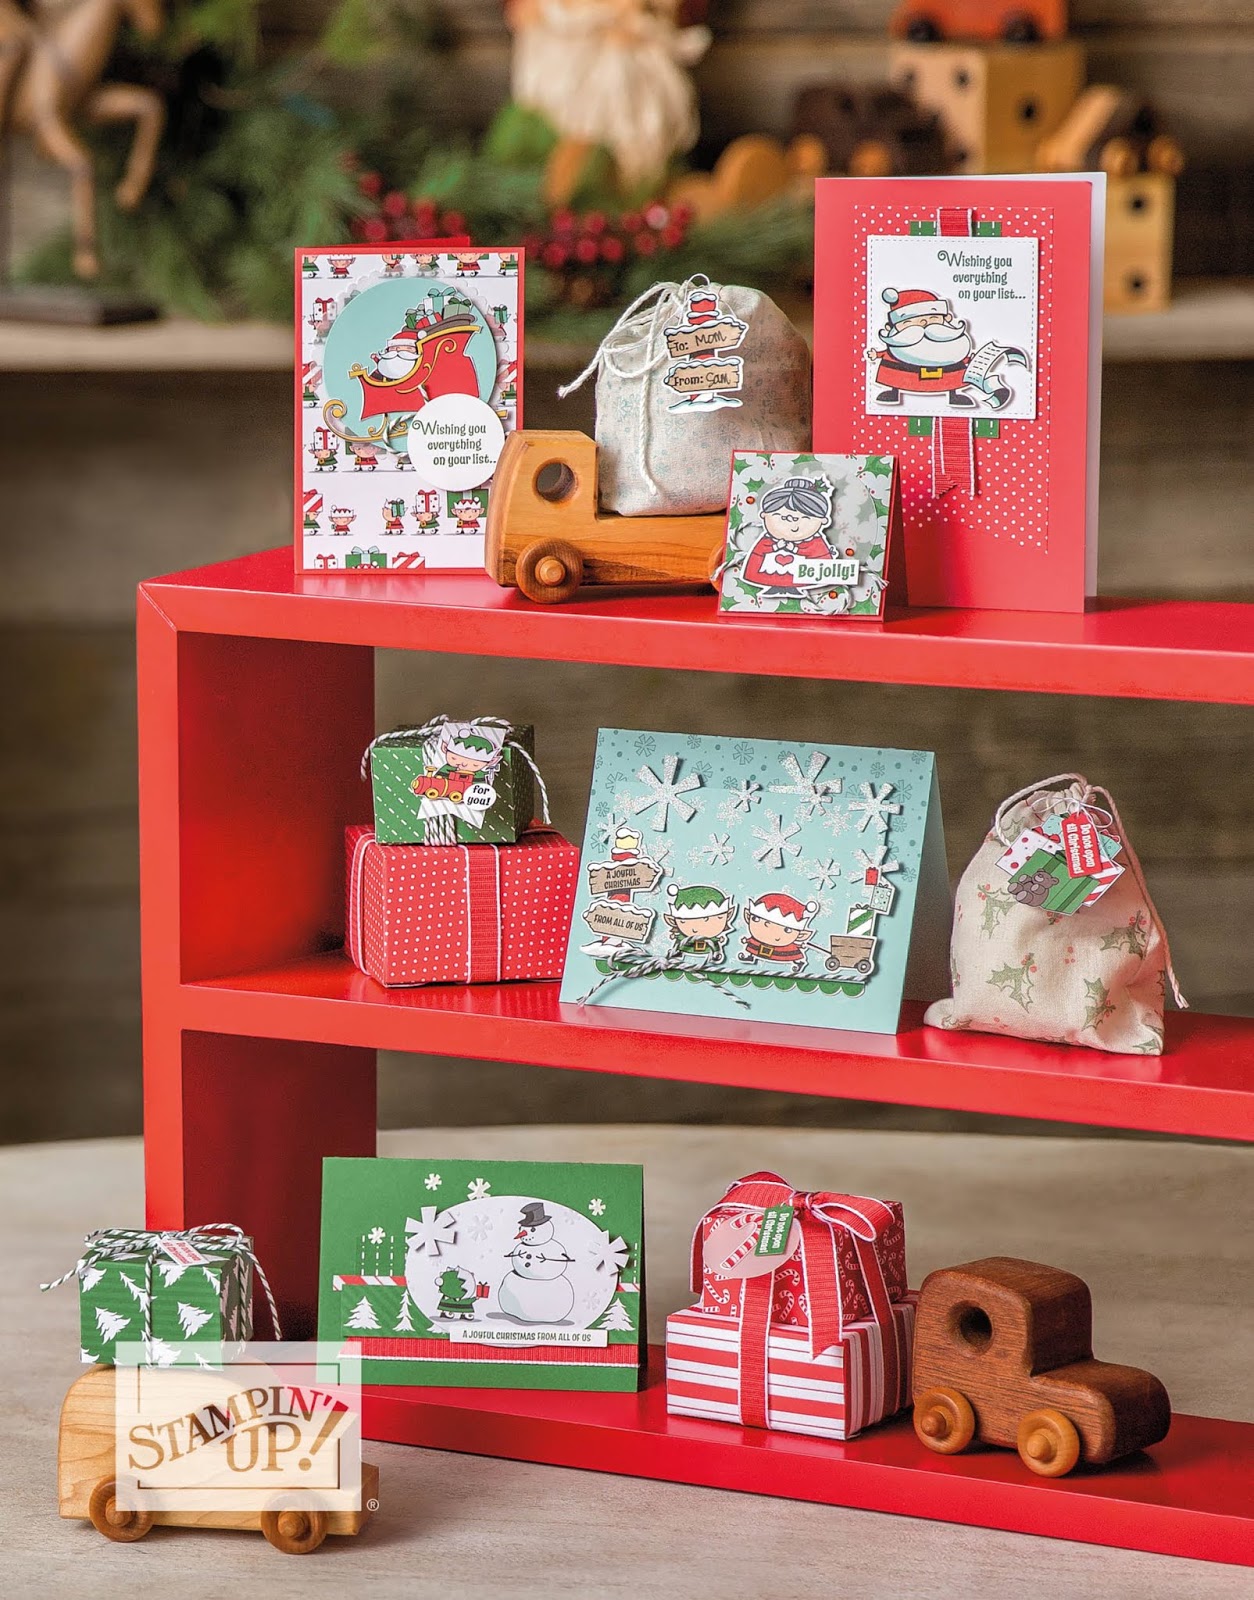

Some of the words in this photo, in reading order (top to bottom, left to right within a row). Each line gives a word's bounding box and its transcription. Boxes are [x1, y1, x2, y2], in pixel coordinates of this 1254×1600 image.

[937, 250, 992, 269] Wishing
[994, 257, 1013, 269] you
[952, 272, 1008, 286] everything
[958, 290, 971, 300] on
[972, 290, 997, 302] your
[998, 288, 1027, 300] list...
[673, 342, 689, 352] To:
[694, 331, 727, 347] Mom
[673, 376, 704, 387] From:
[705, 372, 731, 388] Sam
[412, 420, 467, 437] Wishing
[468, 424, 487, 437] you
[427, 439, 482, 452] everything
[433, 456, 446, 466] on
[448, 456, 472, 467] your
[798, 564, 815, 578] Be
[815, 563, 856, 582] jolly!
[473, 785, 490, 795] for
[467, 797, 491, 806] you!
[1080, 823, 1092, 835] Do
[1082, 835, 1092, 847] not
[606, 871, 612, 880] A
[612, 868, 637, 879] JOYFUL
[604, 878, 641, 889] CHRISTMAS
[594, 914, 613, 925] FROM
[613, 918, 625, 928] ALL
[625, 922, 634, 931] OF
[634, 923, 644, 932] US
[462, 1330, 468, 1338] A
[469, 1331, 495, 1339] JOYFUL
[496, 1332, 536, 1341] CHRISTMAS
[537, 1333, 557, 1341] FROM
[558, 1333, 571, 1342] ALL
[572, 1334, 581, 1342] OF
[582, 1334, 592, 1342] US
